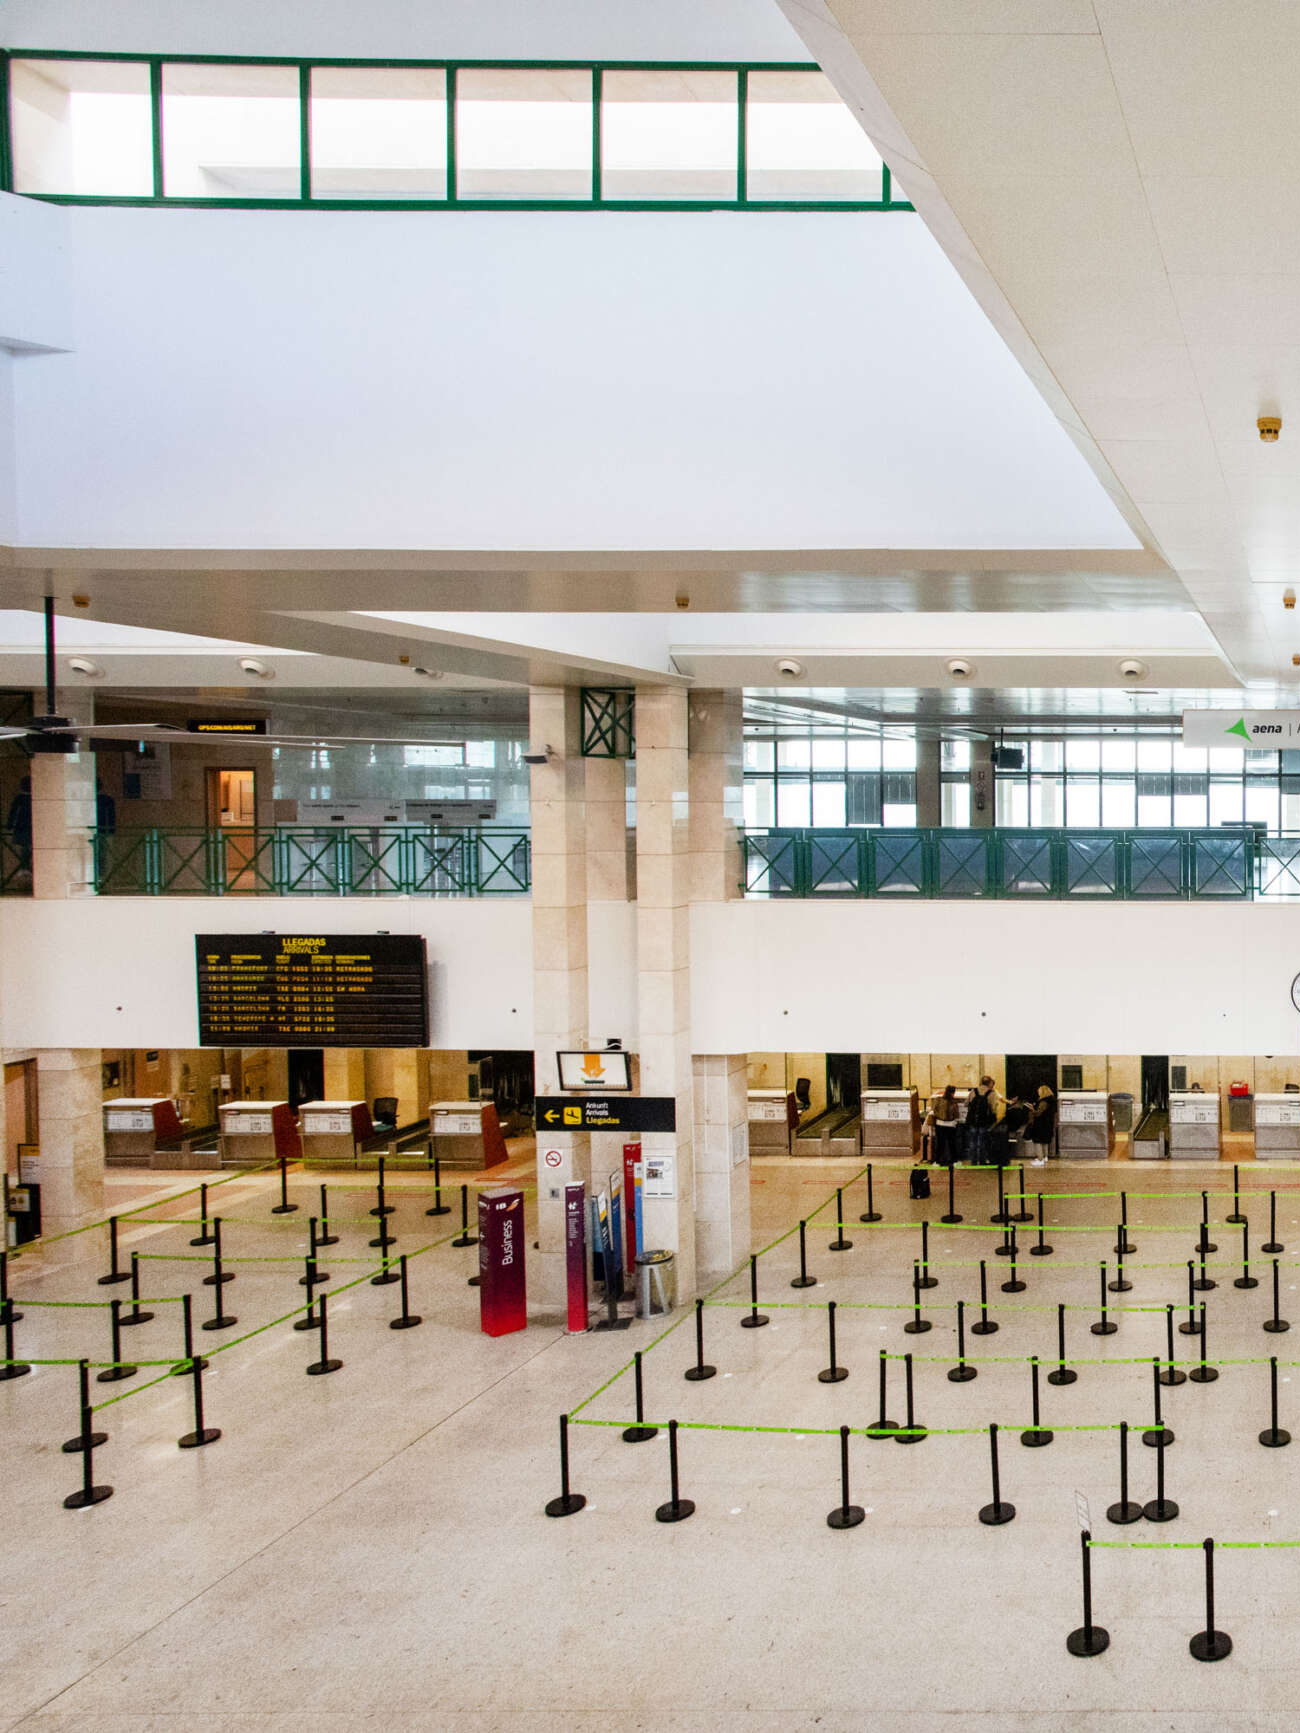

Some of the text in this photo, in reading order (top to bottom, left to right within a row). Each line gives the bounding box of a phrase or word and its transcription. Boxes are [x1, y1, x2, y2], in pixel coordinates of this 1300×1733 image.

[1252, 724, 1282, 734] aena
[282, 938, 326, 946] LLEGADAS
[586, 1117, 620, 1125] Llegadas
[502, 1219, 513, 1266] Business
